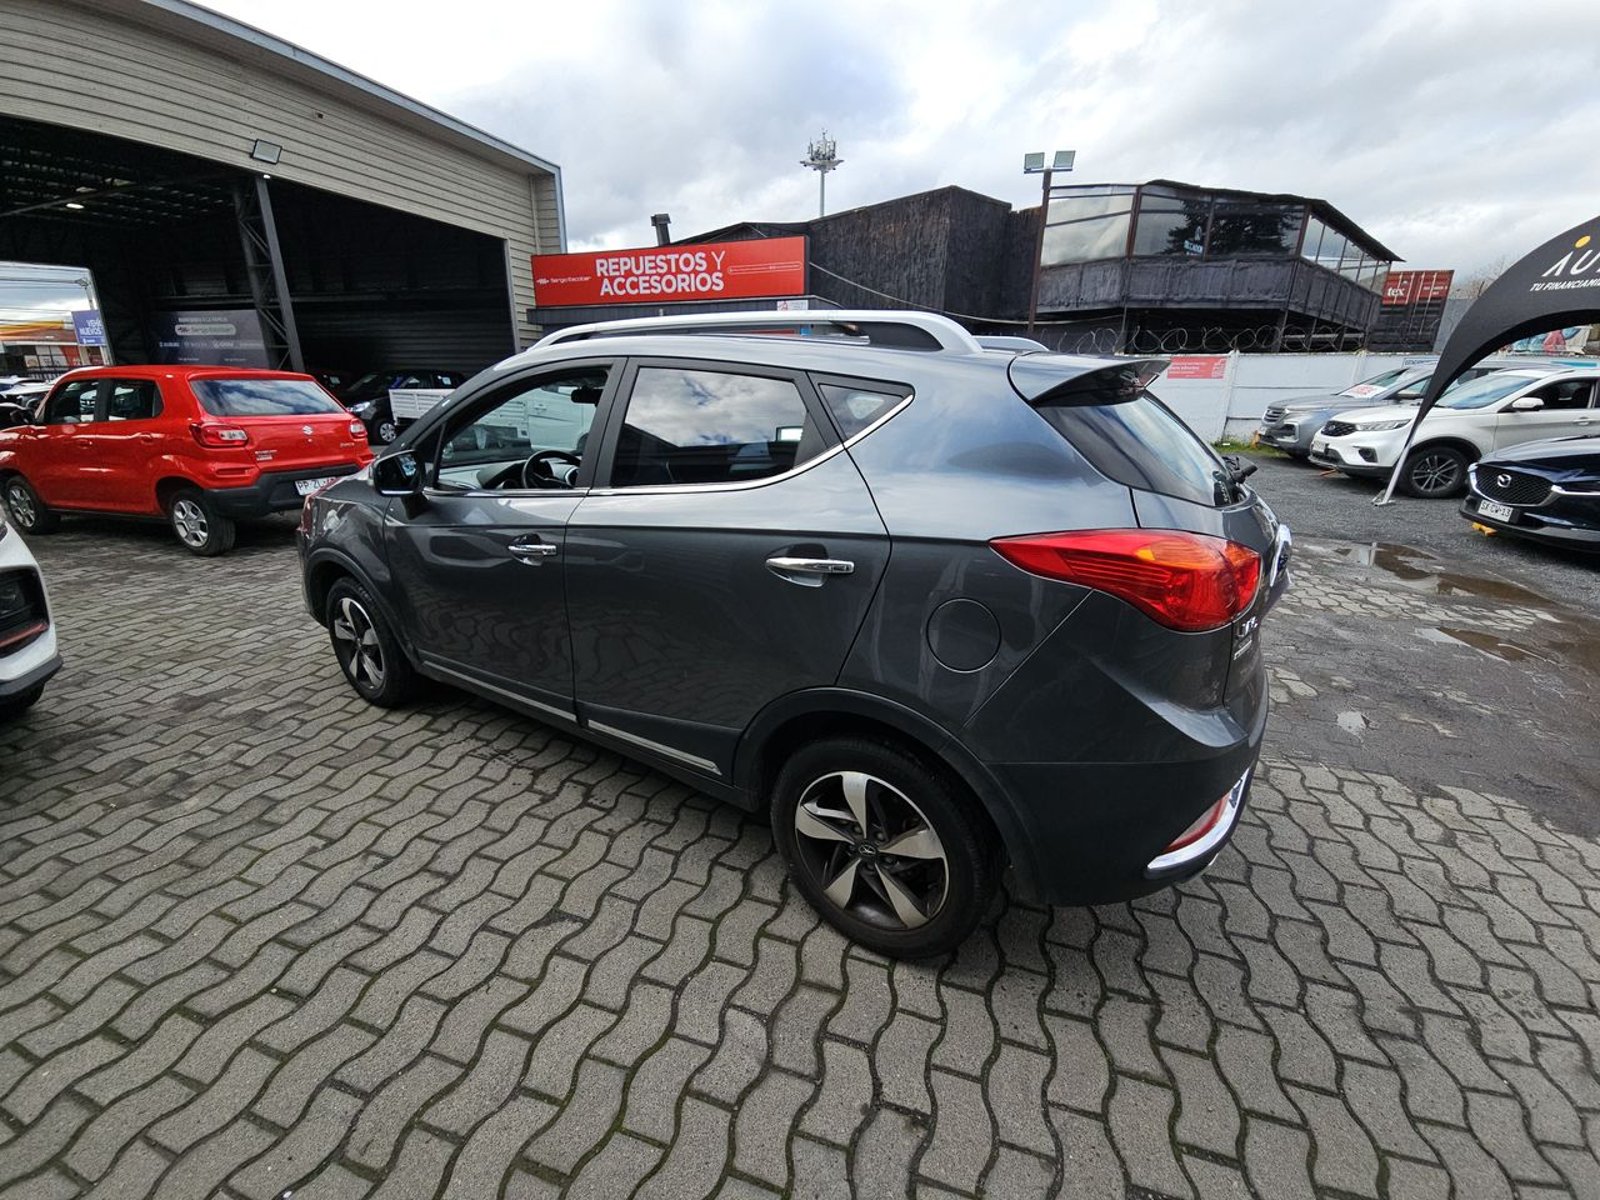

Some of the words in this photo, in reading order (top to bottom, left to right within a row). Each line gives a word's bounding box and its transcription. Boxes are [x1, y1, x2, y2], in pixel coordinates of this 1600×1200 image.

[595, 252, 707, 277] REPUESTOS
[711, 250, 725, 270] Y
[600, 271, 724, 296] ACCESORIOS
[1530, 282, 1546, 291] TU
